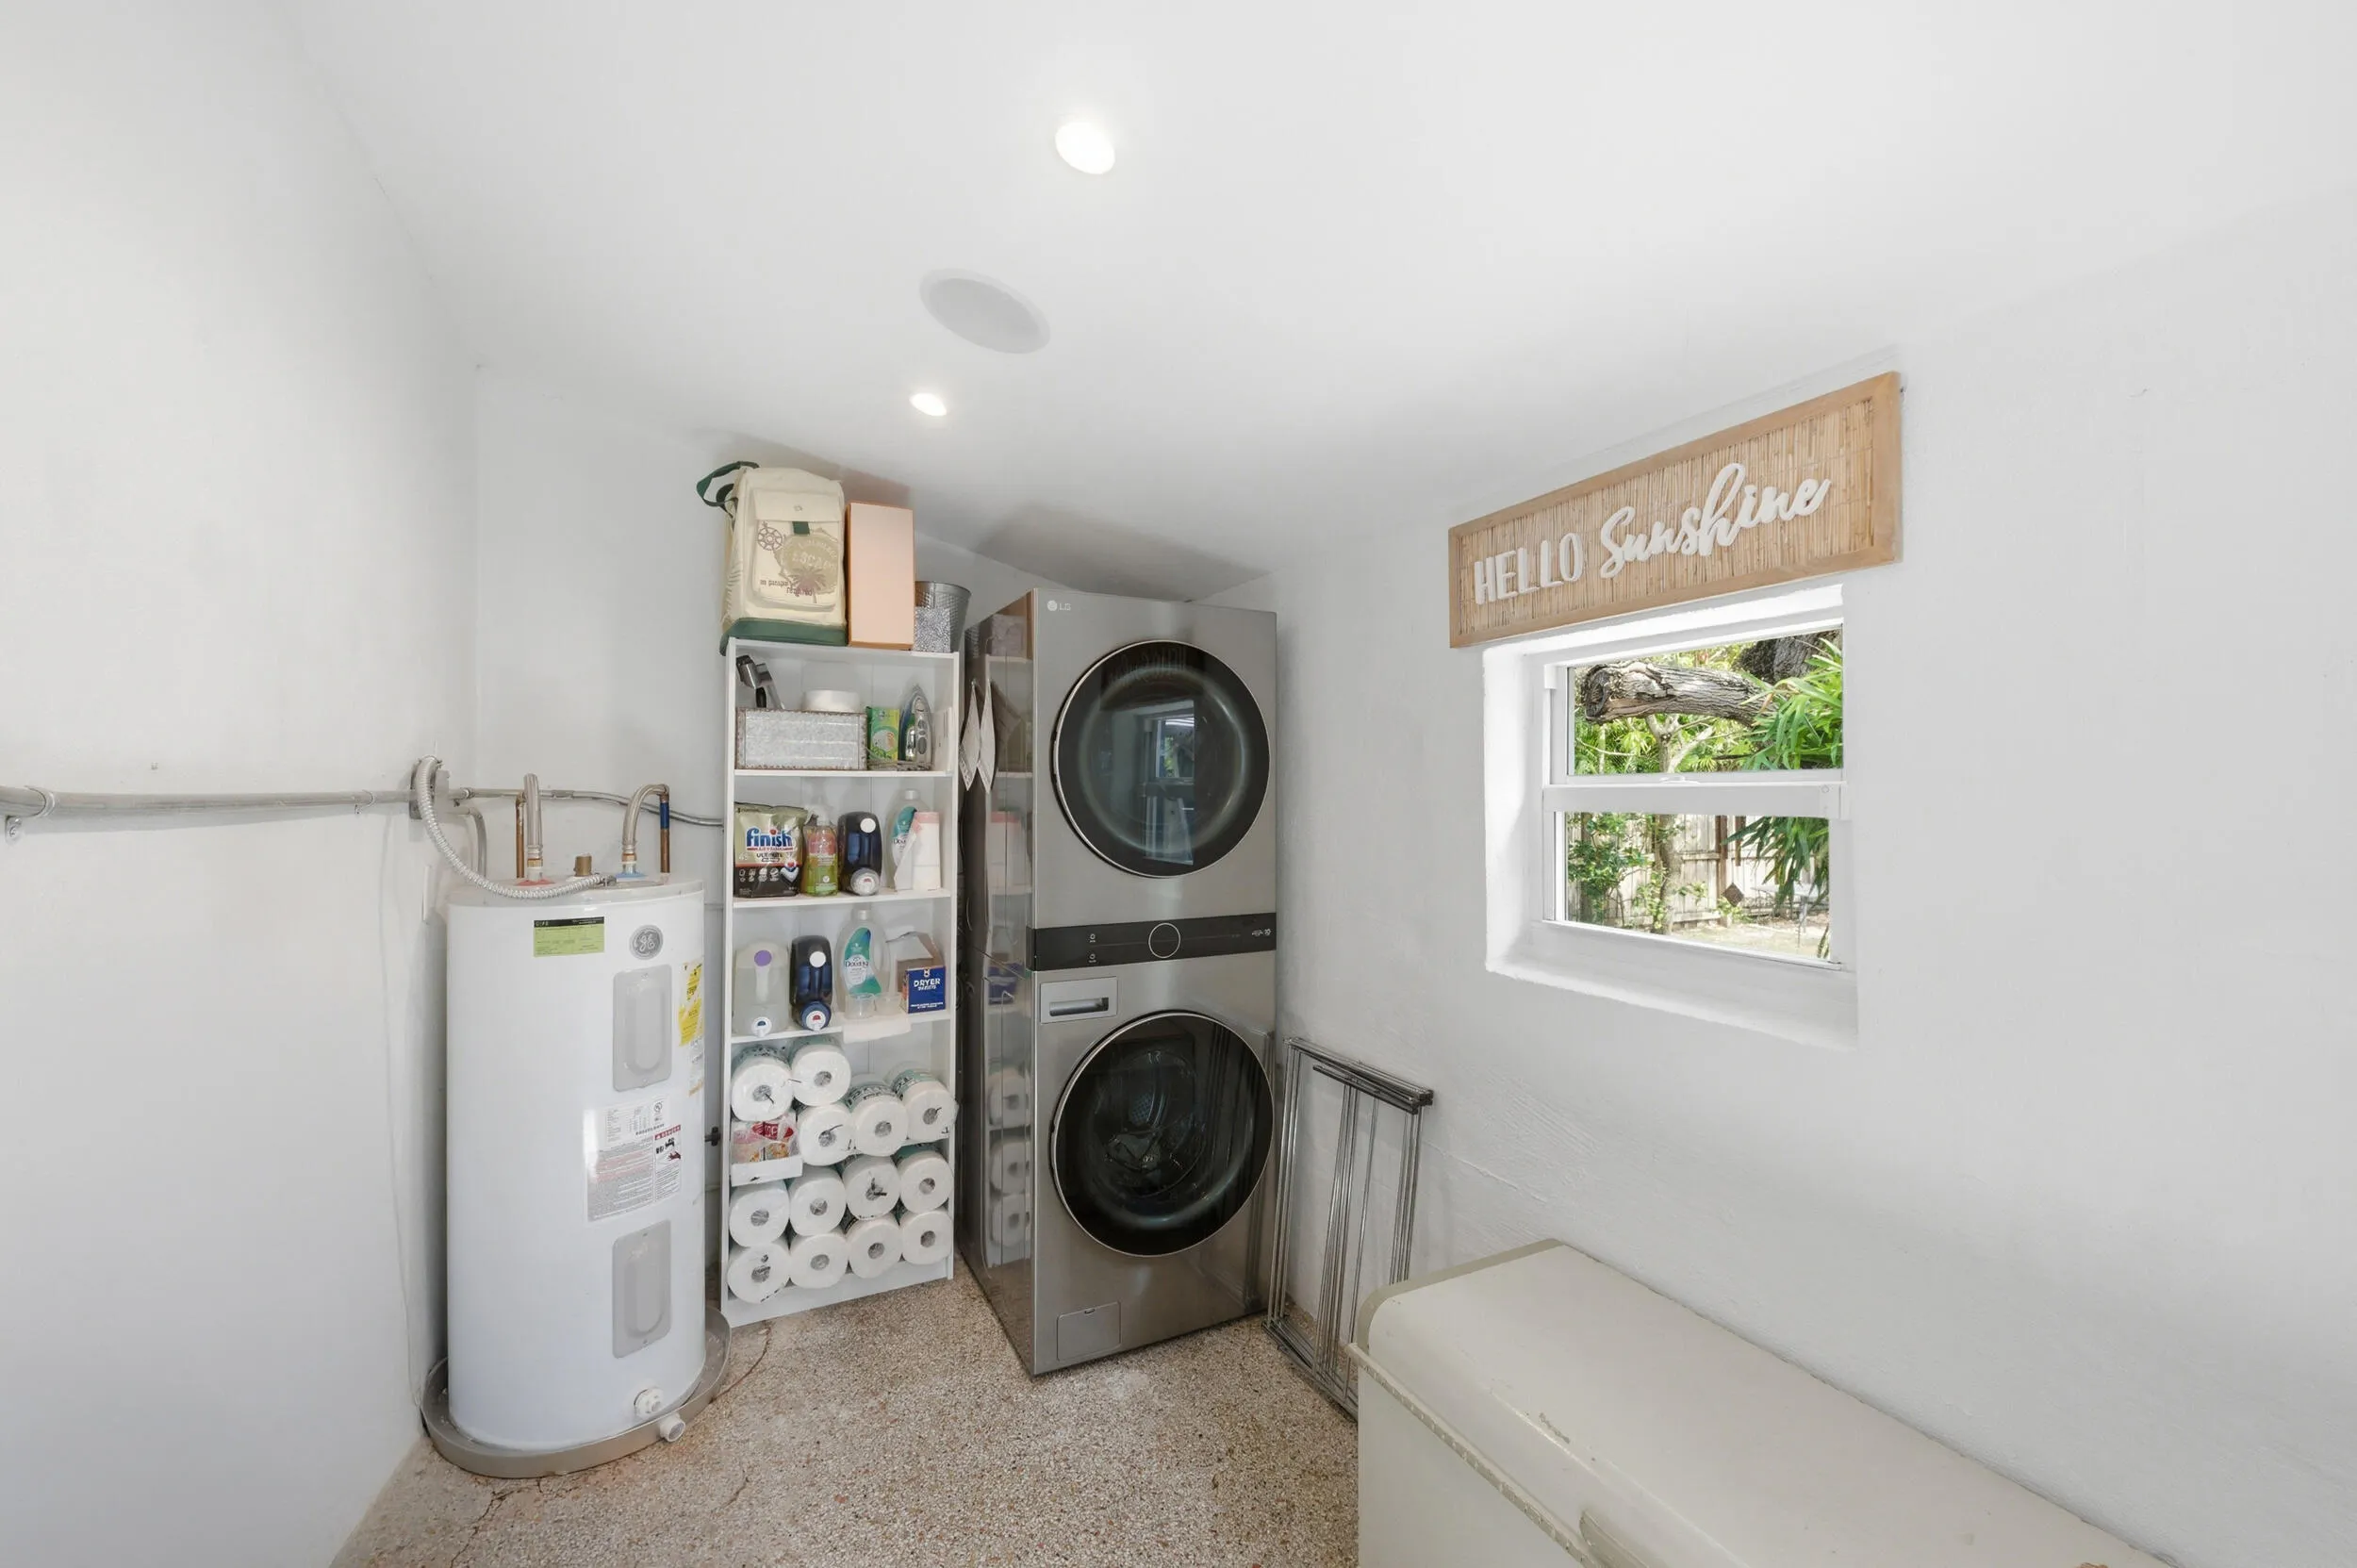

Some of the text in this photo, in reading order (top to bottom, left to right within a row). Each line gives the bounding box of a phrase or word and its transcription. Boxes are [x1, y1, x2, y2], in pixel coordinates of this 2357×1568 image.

[1474, 462, 1831, 605] HELLO Sunshine
[746, 827, 793, 847] finish
[914, 978, 941, 987] DRYER
